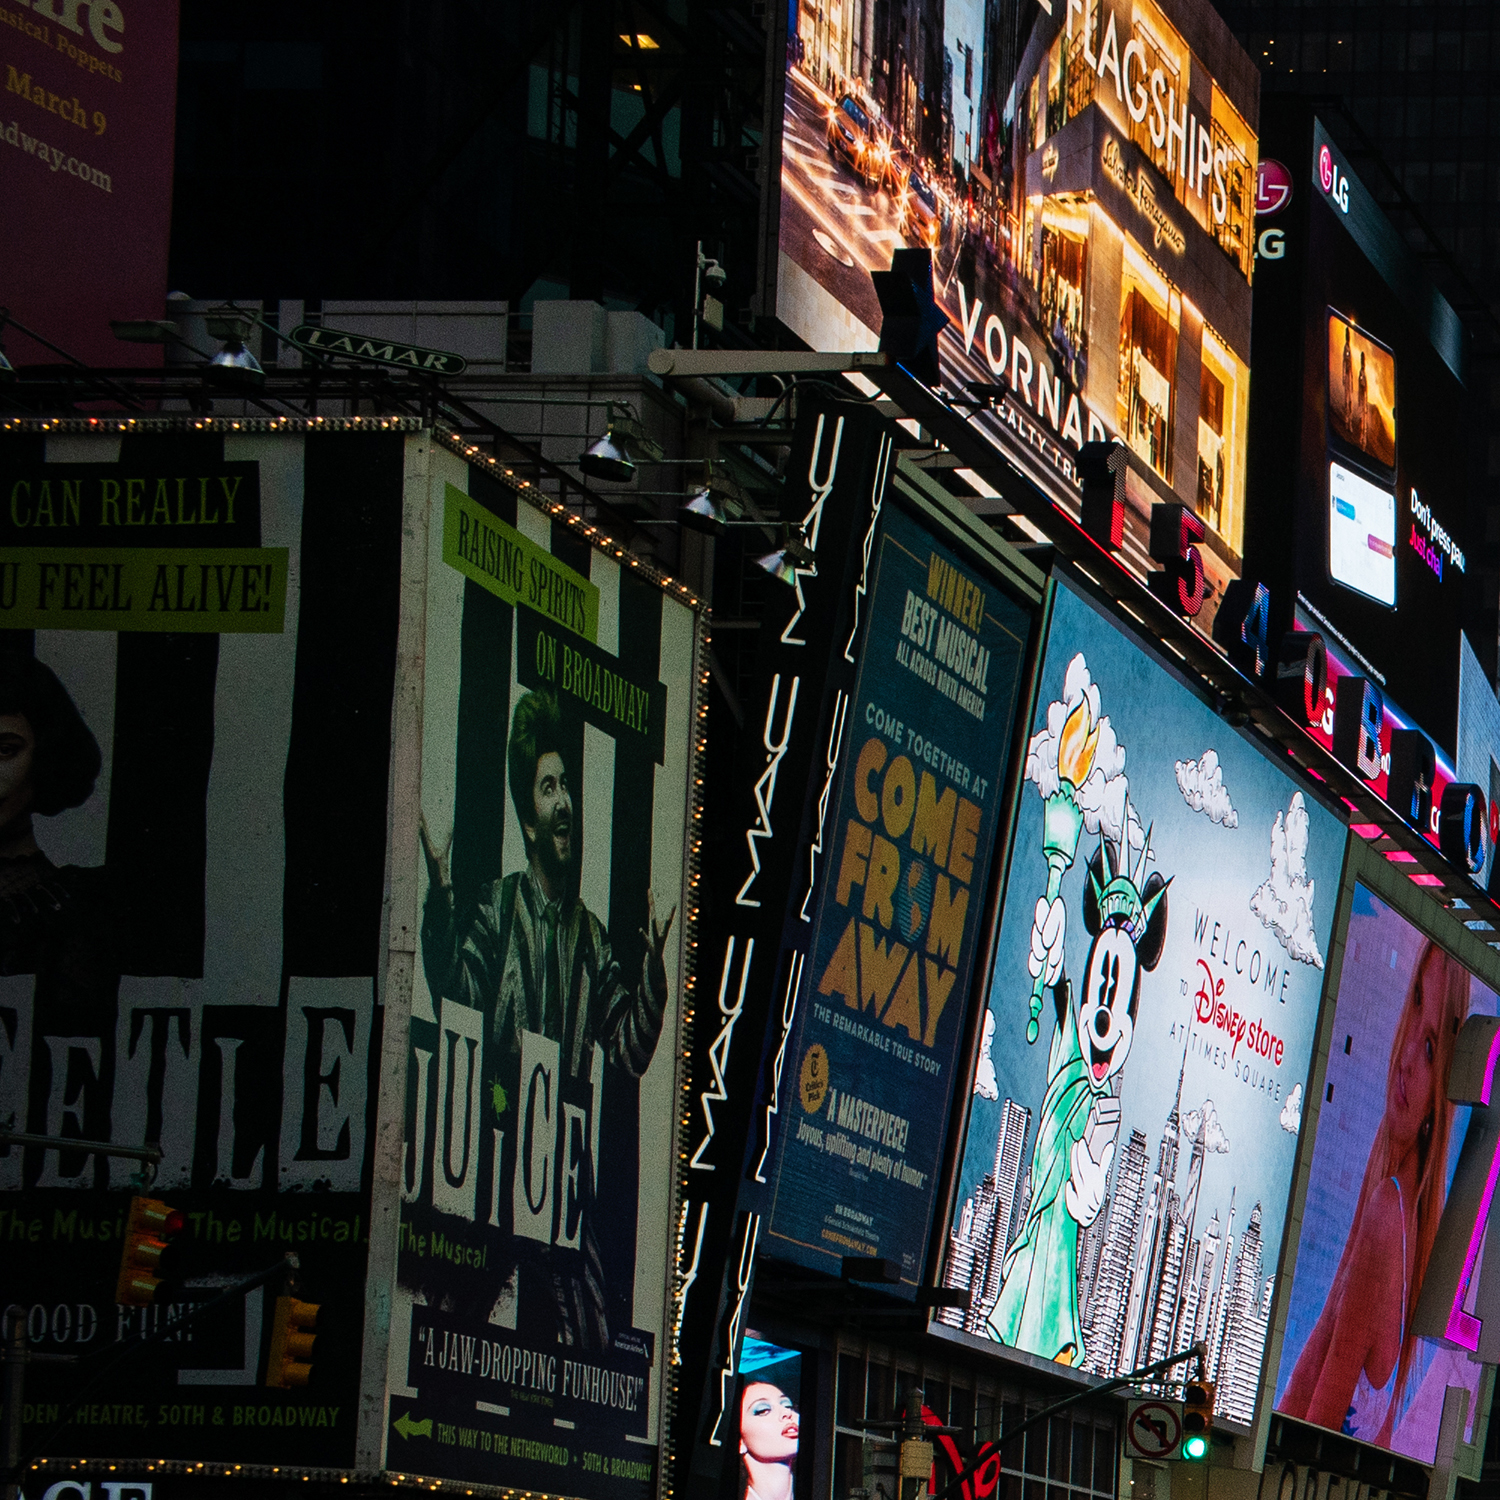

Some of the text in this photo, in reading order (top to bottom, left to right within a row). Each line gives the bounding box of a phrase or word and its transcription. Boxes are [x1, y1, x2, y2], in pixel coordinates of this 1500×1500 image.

[5, 64, 107, 135] March 9
[1332, 163, 1350, 214] LG
[306, 330, 449, 373] LAMAR
[11, 476, 243, 528] CAN REALLY
[39, 563, 133, 611] FEEL
[149, 563, 272, 612] ALIVE!
[458, 509, 586, 635] RAISING SPIRITS
[926, 551, 987, 635] WINNER!
[536, 630, 650, 735] ON BROADWAY!
[900, 588, 991, 696] BEST MUSICAL
[864, 701, 989, 800] COME TOGETHER AT
[854, 737, 984, 873] COME
[818, 928, 960, 1052] AWAY
[1193, 907, 1291, 1005] WELCOME
[813, 1002, 942, 1078] THE REMARKABLE TRUE STORY
[1179, 958, 1285, 1067] TO Disney store
[1169, 1021, 1281, 1103] AT TIMES SQUARE
[187, 1210, 370, 1245] The Musical.
[399, 1221, 490, 1271] The Musical.
